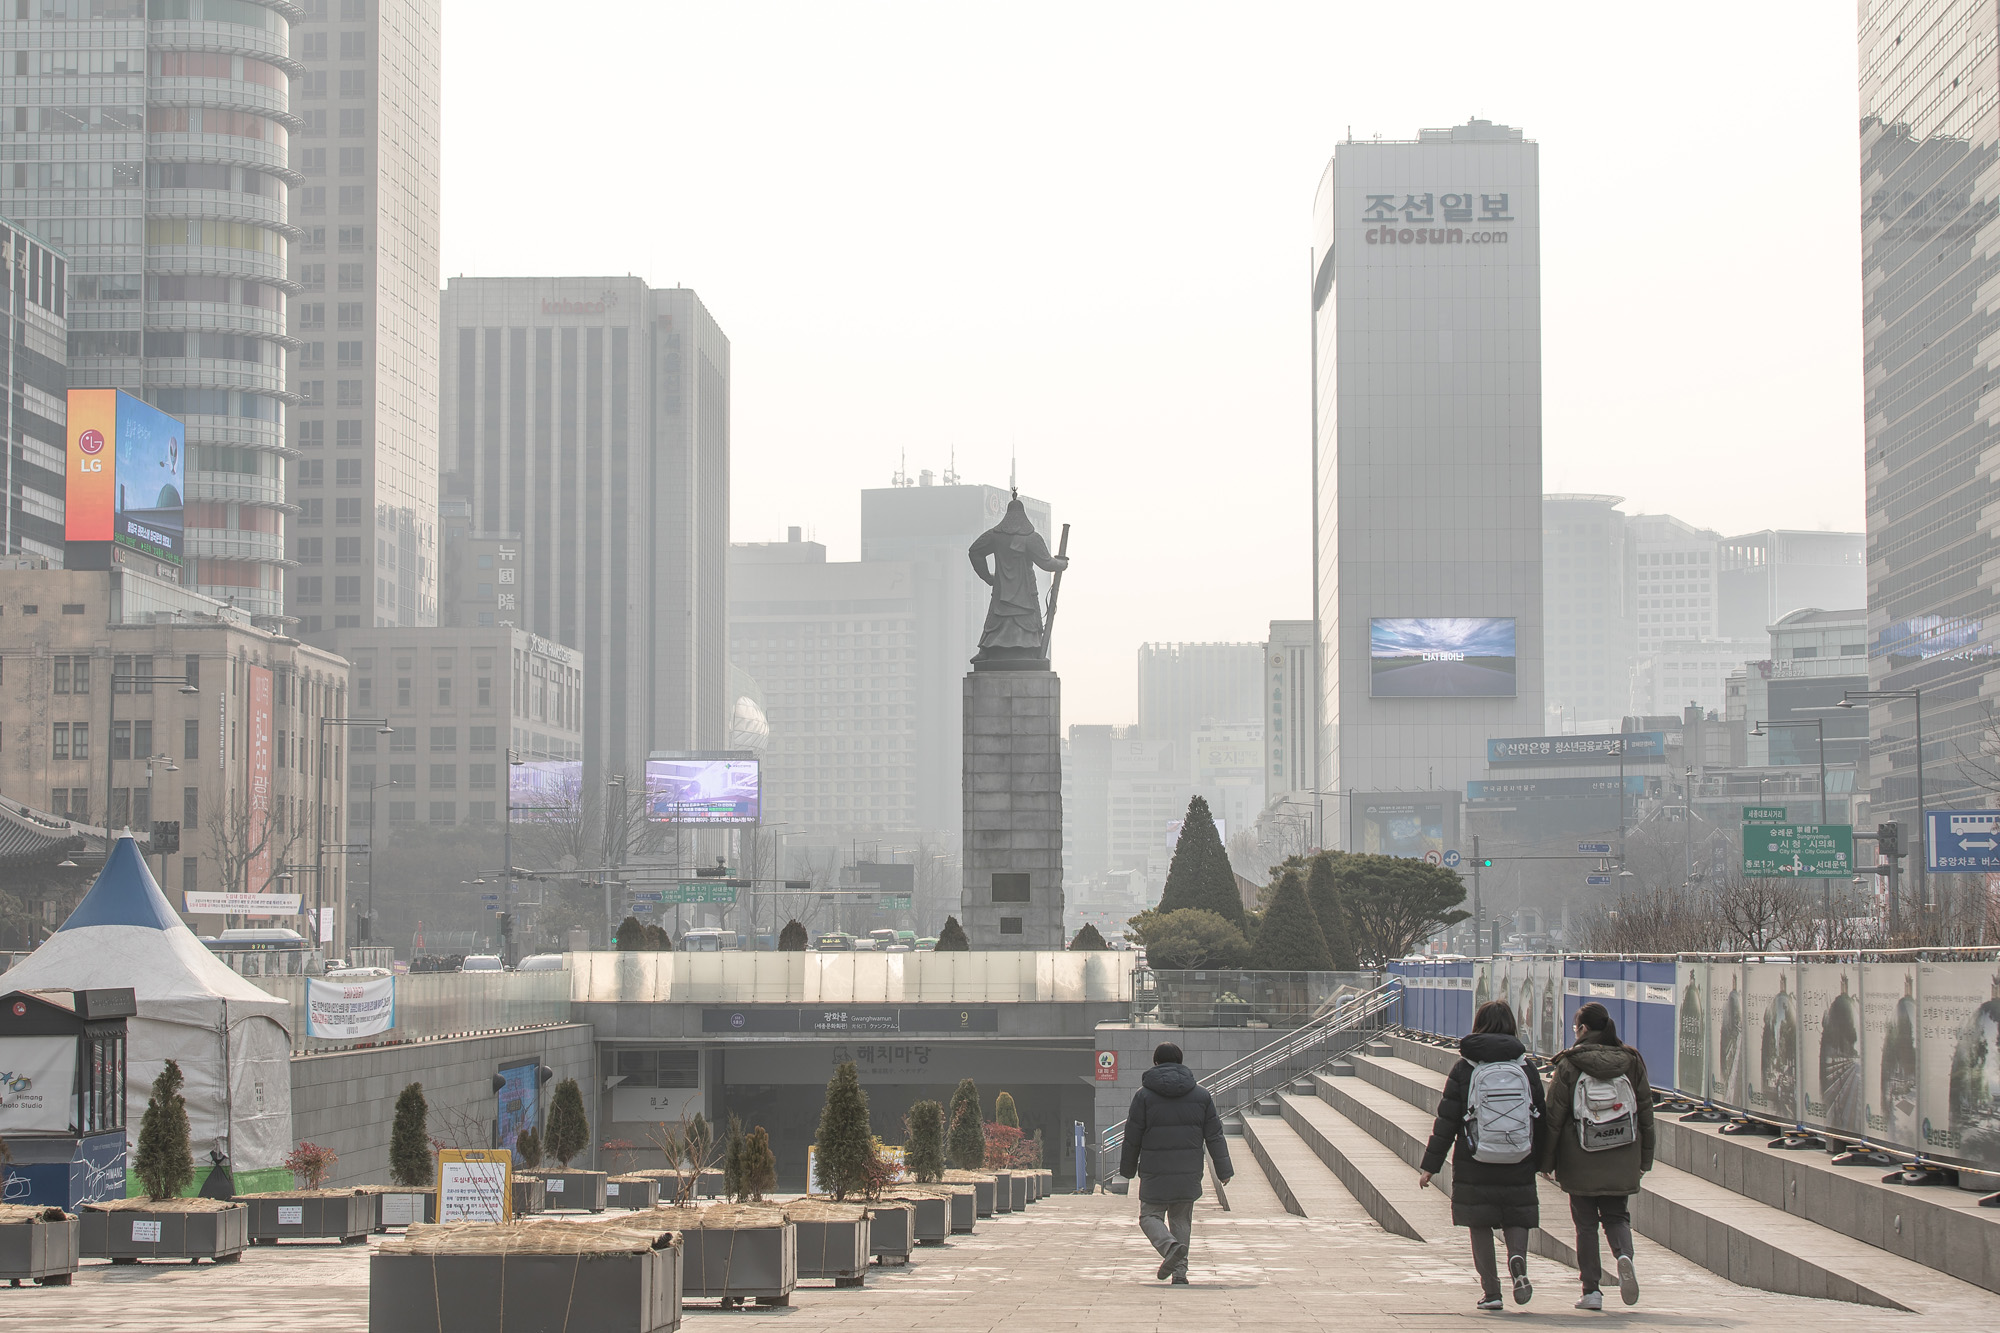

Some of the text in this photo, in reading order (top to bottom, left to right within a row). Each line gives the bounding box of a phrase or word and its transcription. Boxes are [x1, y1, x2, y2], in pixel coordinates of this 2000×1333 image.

[1362, 192, 1514, 222] 조선일보
[1365, 224, 1508, 244] chosun.com
[542, 297, 605, 314] kobaco
[81, 459, 102, 472] LG
[1422, 652, 1465, 661] 다시 태어난
[1272, 673, 1283, 777] 서울특별시의회
[1507, 741, 1550, 756] 신한은행
[1482, 784, 1536, 792] 한국금융사박물관
[1748, 809, 1783, 818] 세종대로사거리
[1770, 828, 1794, 837] 숭례문
[1809, 840, 1836, 848] 시의회
[1745, 860, 1847, 869] 종로1가 서대문역
[1938, 856, 1976, 867] 중앙차로
[824, 1012, 847, 1021] 광화문
[960, 1012, 968, 1022] 9
[857, 1046, 932, 1064] 해치마당
[1593, 1126, 1625, 1139] ASBM
[105, 1166, 123, 1178] HIMANG
